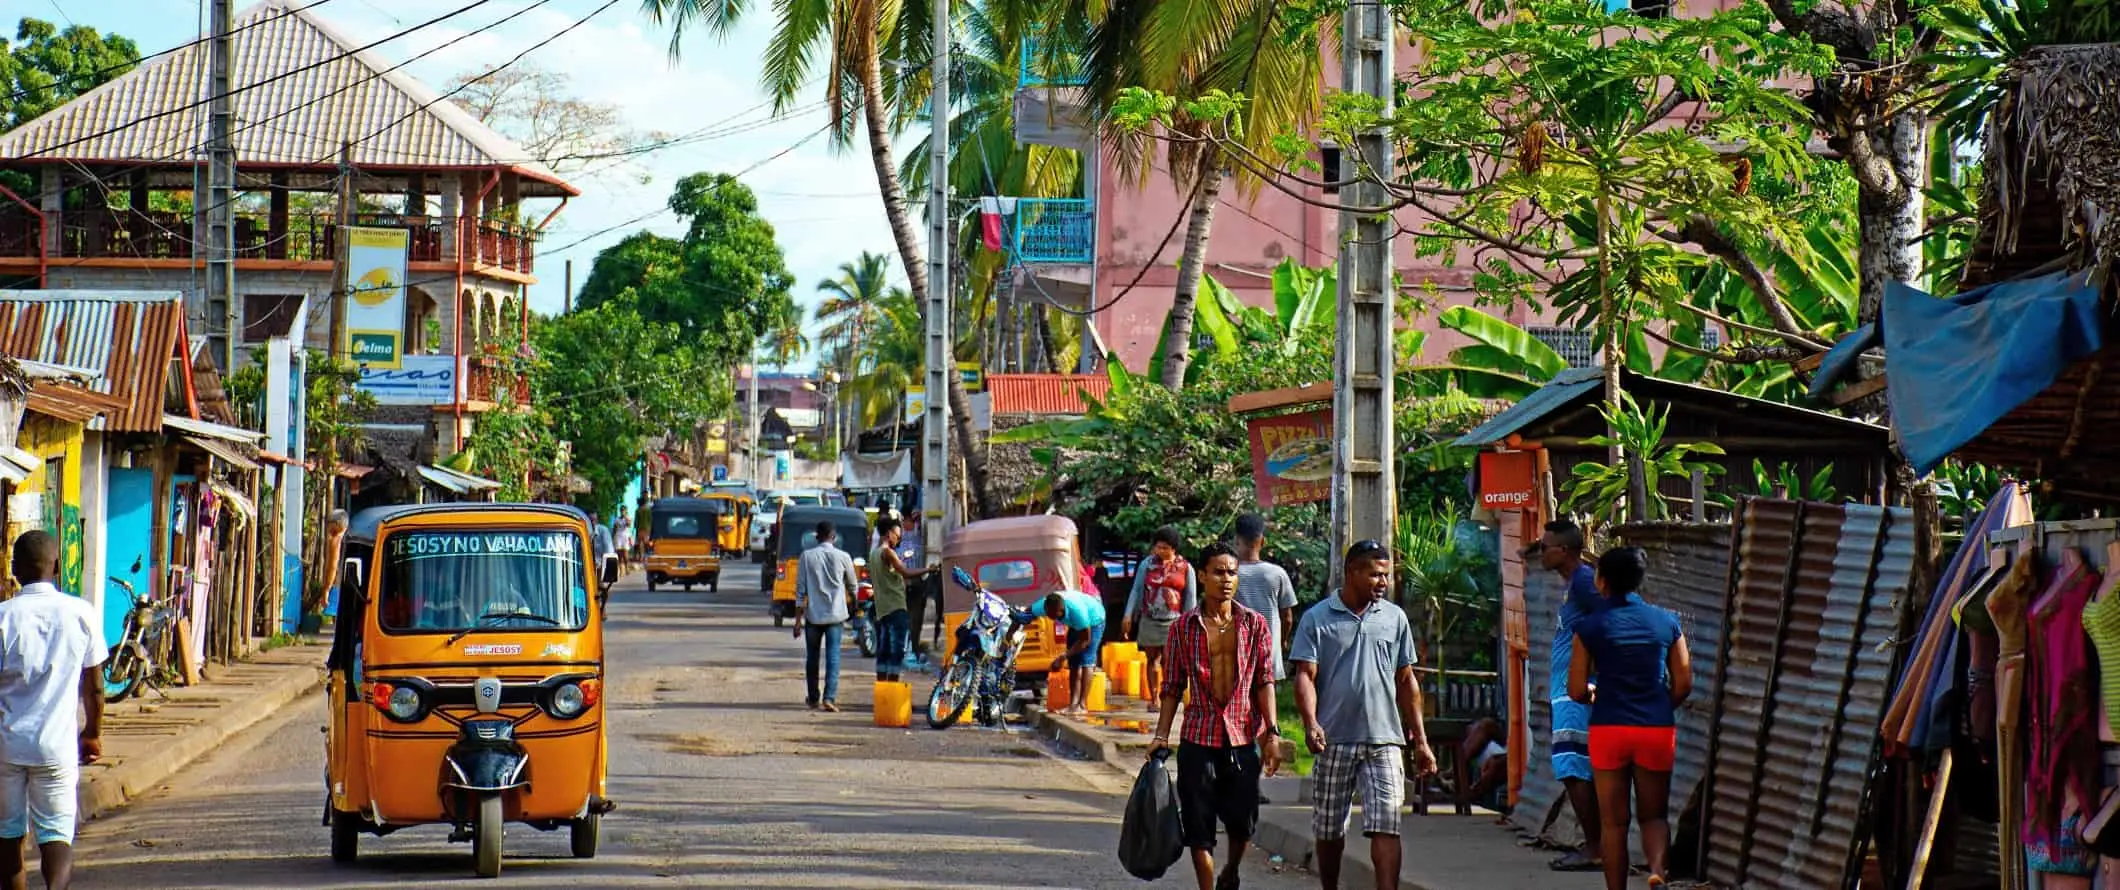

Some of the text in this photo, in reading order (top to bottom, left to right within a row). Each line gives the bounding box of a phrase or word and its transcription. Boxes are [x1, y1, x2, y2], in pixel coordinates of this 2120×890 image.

[1485, 492, 1529, 504] orange
[392, 536, 451, 556] JESOSY
[454, 536, 480, 553] NO
